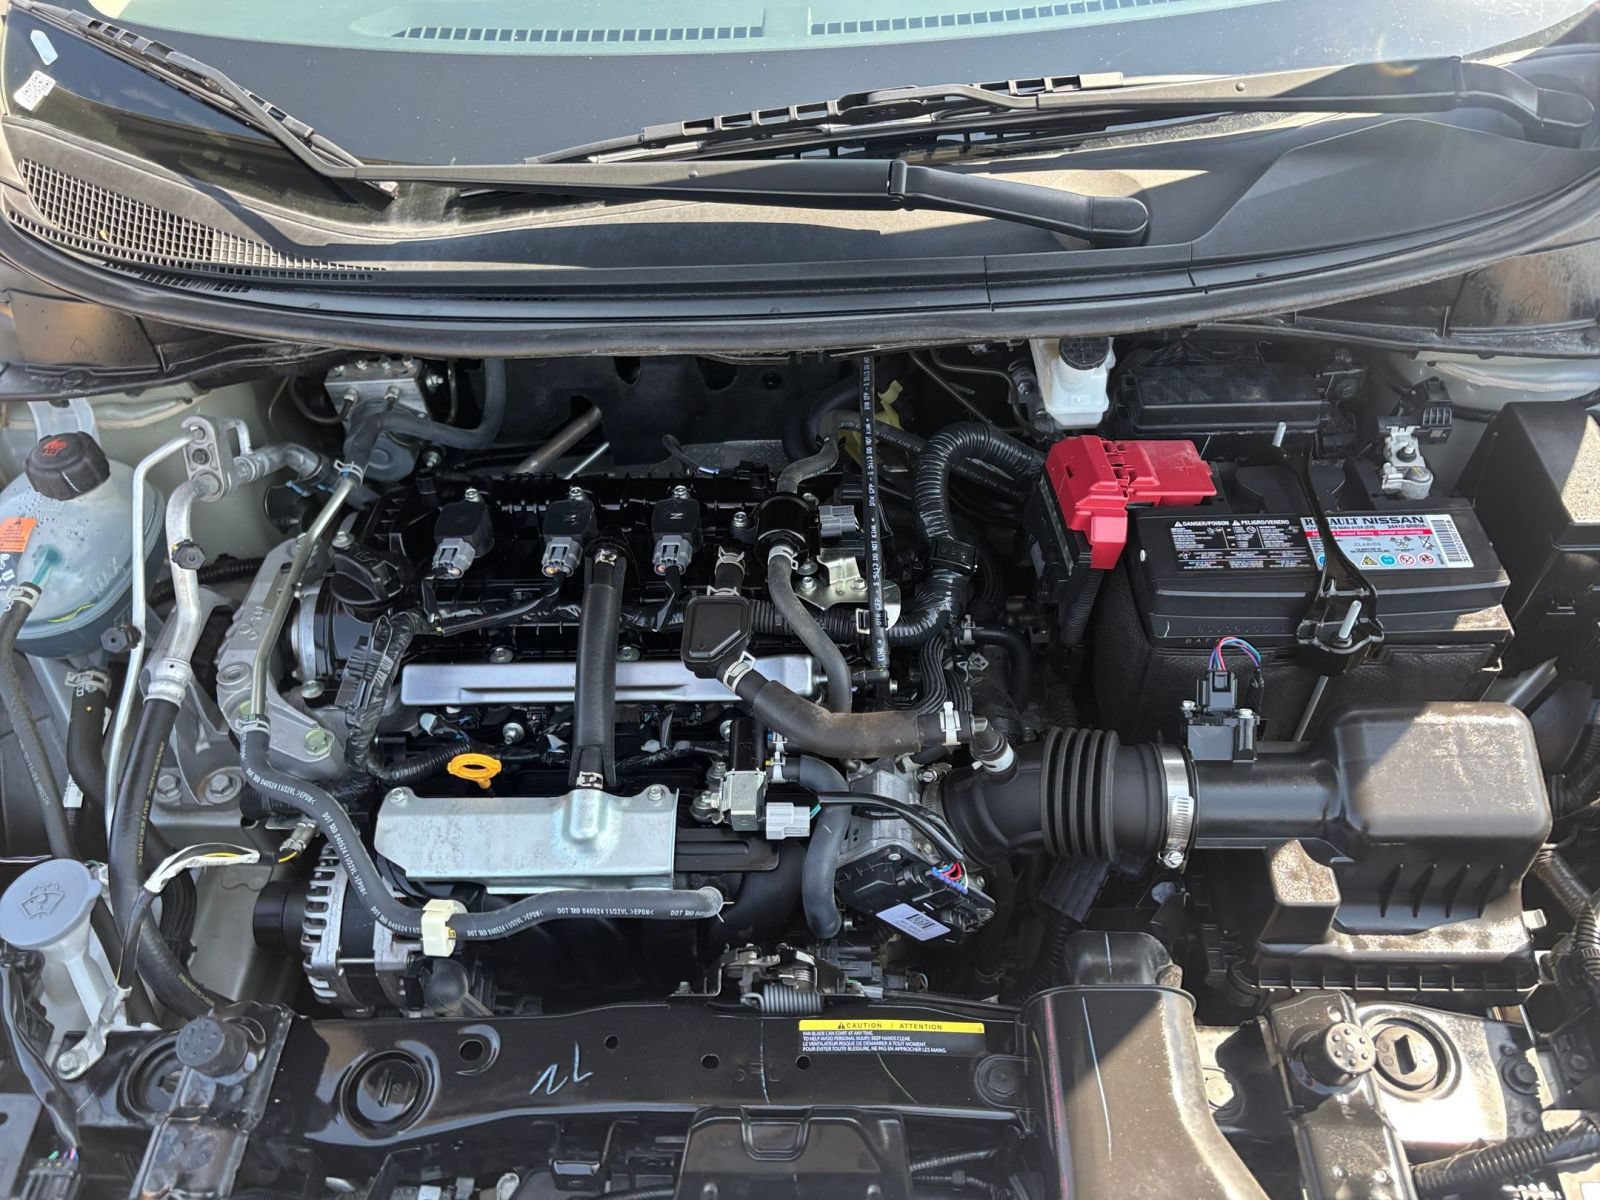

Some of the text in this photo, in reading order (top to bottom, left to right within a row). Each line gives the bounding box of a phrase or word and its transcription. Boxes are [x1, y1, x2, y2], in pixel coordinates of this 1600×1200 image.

[1304, 516, 1425, 526] RAULT NISSAN
[322, 811, 333, 824] DOT
[670, 909, 684, 917] DOT
